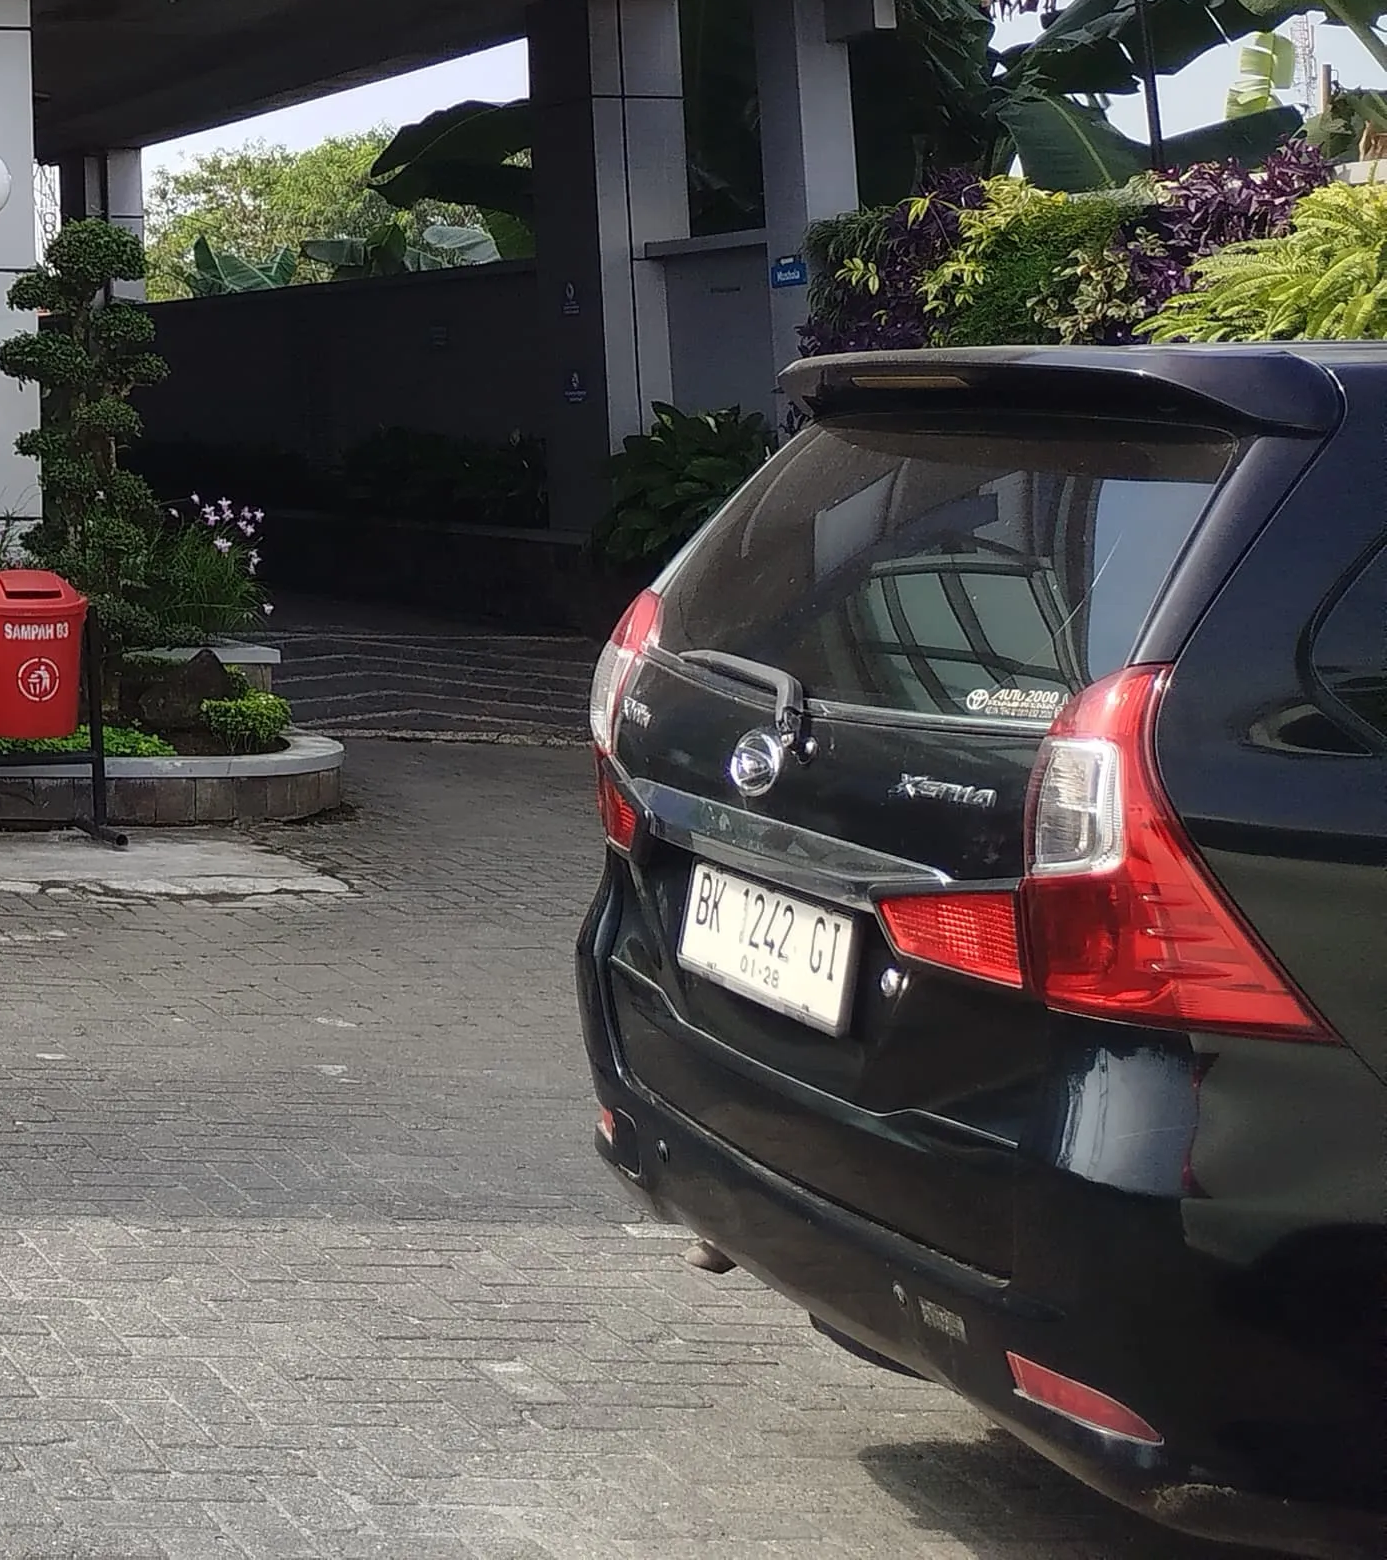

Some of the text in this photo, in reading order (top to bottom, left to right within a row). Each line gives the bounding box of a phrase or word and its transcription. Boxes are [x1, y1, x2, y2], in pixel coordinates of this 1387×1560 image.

[4, 622, 55, 640] SAMPAH
[887, 772, 998, 808] Xenia
[694, 871, 727, 935] BK
[738, 887, 796, 964] 1242
